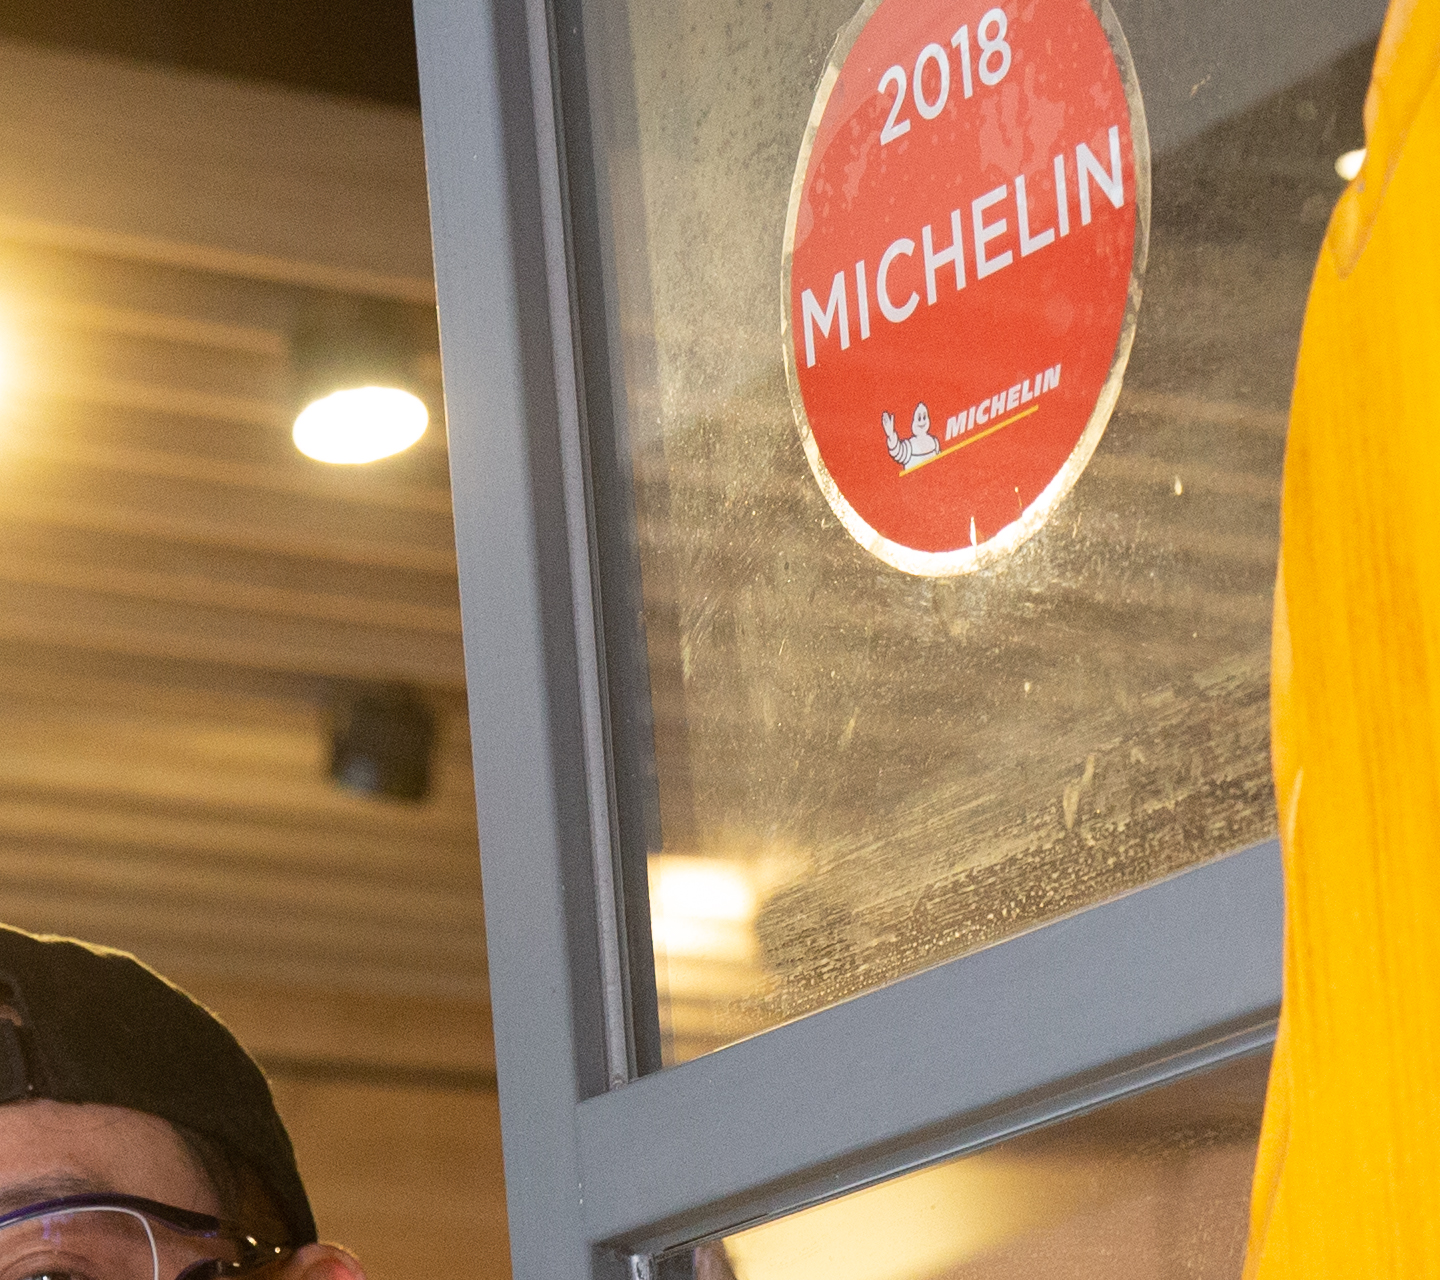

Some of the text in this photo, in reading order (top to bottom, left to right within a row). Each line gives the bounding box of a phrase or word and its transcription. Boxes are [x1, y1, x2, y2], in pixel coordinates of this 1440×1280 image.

[876, 7, 1012, 146] 2018
[800, 125, 1126, 369] MICHELIN
[944, 364, 1062, 442] MICHELIN
